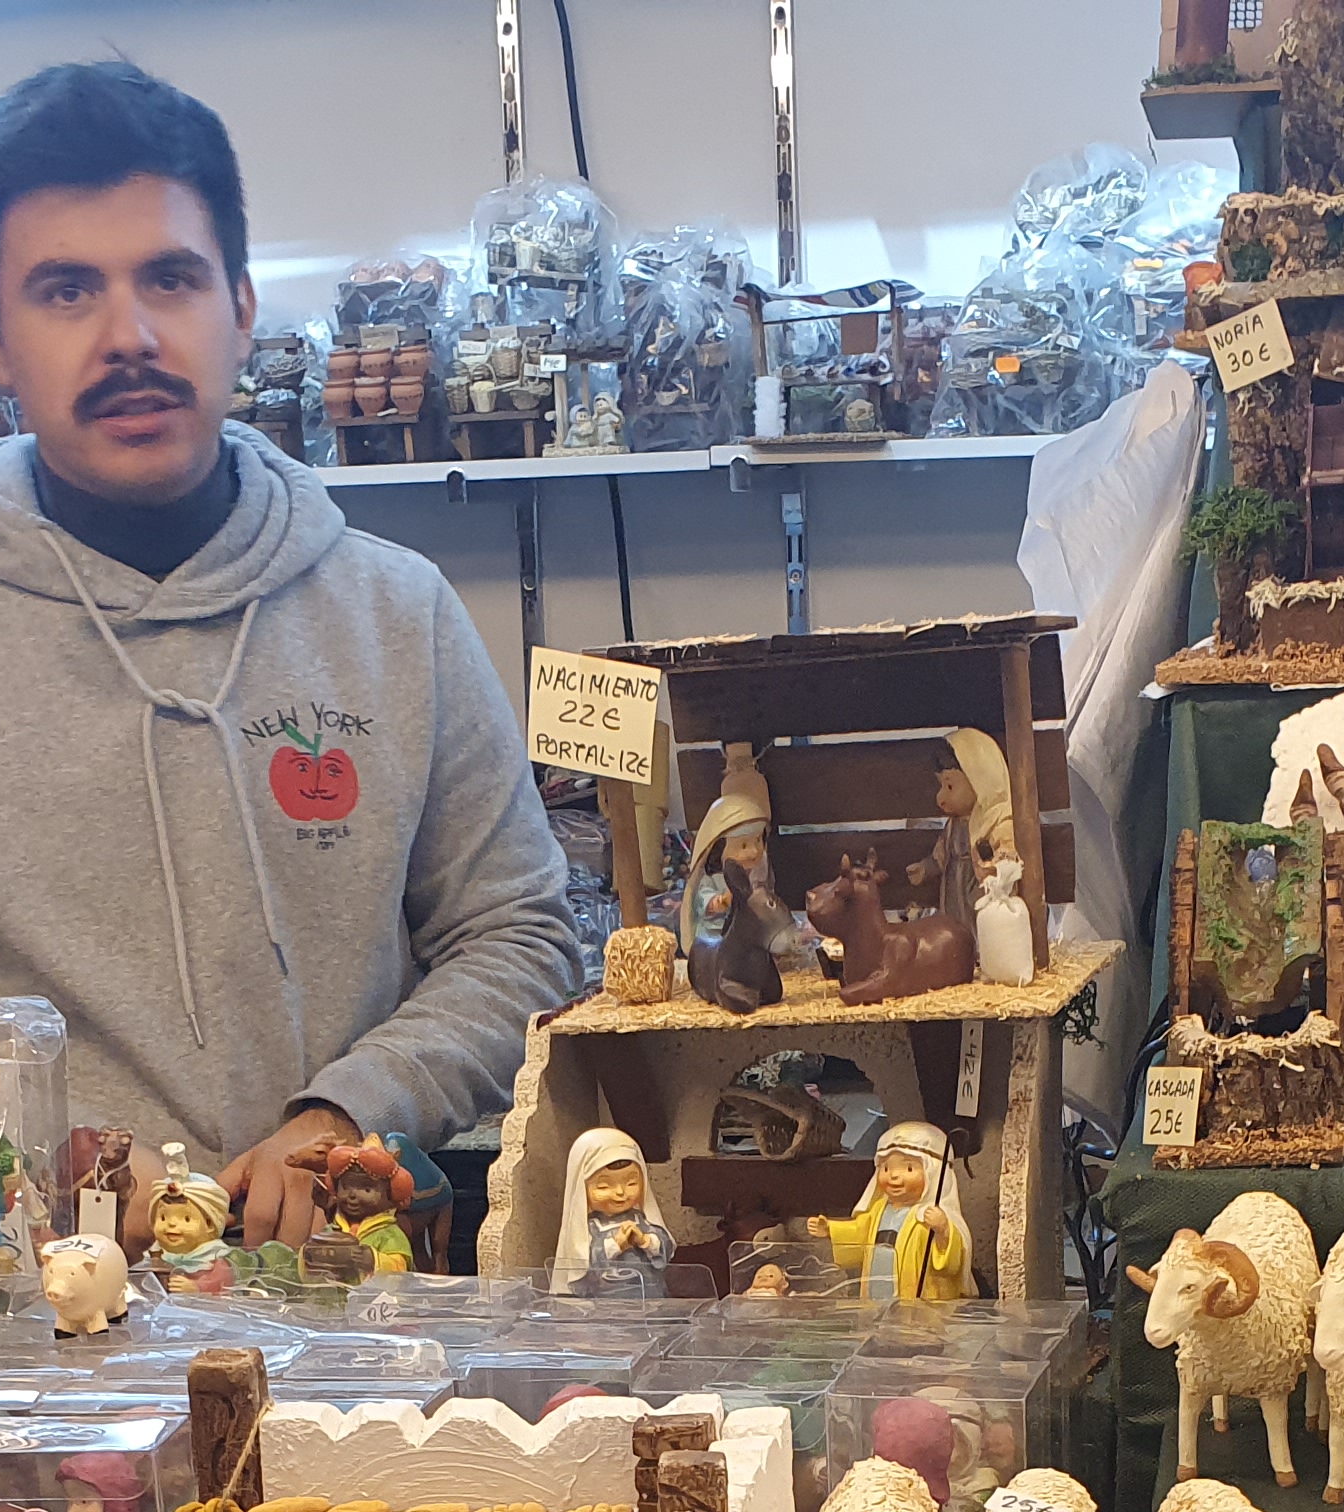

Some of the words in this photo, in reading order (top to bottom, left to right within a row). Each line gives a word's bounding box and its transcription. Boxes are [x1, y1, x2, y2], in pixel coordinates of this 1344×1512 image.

[536, 664, 660, 702] NACIMIENTO
[240, 705, 300, 748] NEW
[311, 700, 375, 737] YORK
[1147, 1078, 1196, 1101] CASCADA
[1149, 1107, 1184, 1136] 25€
